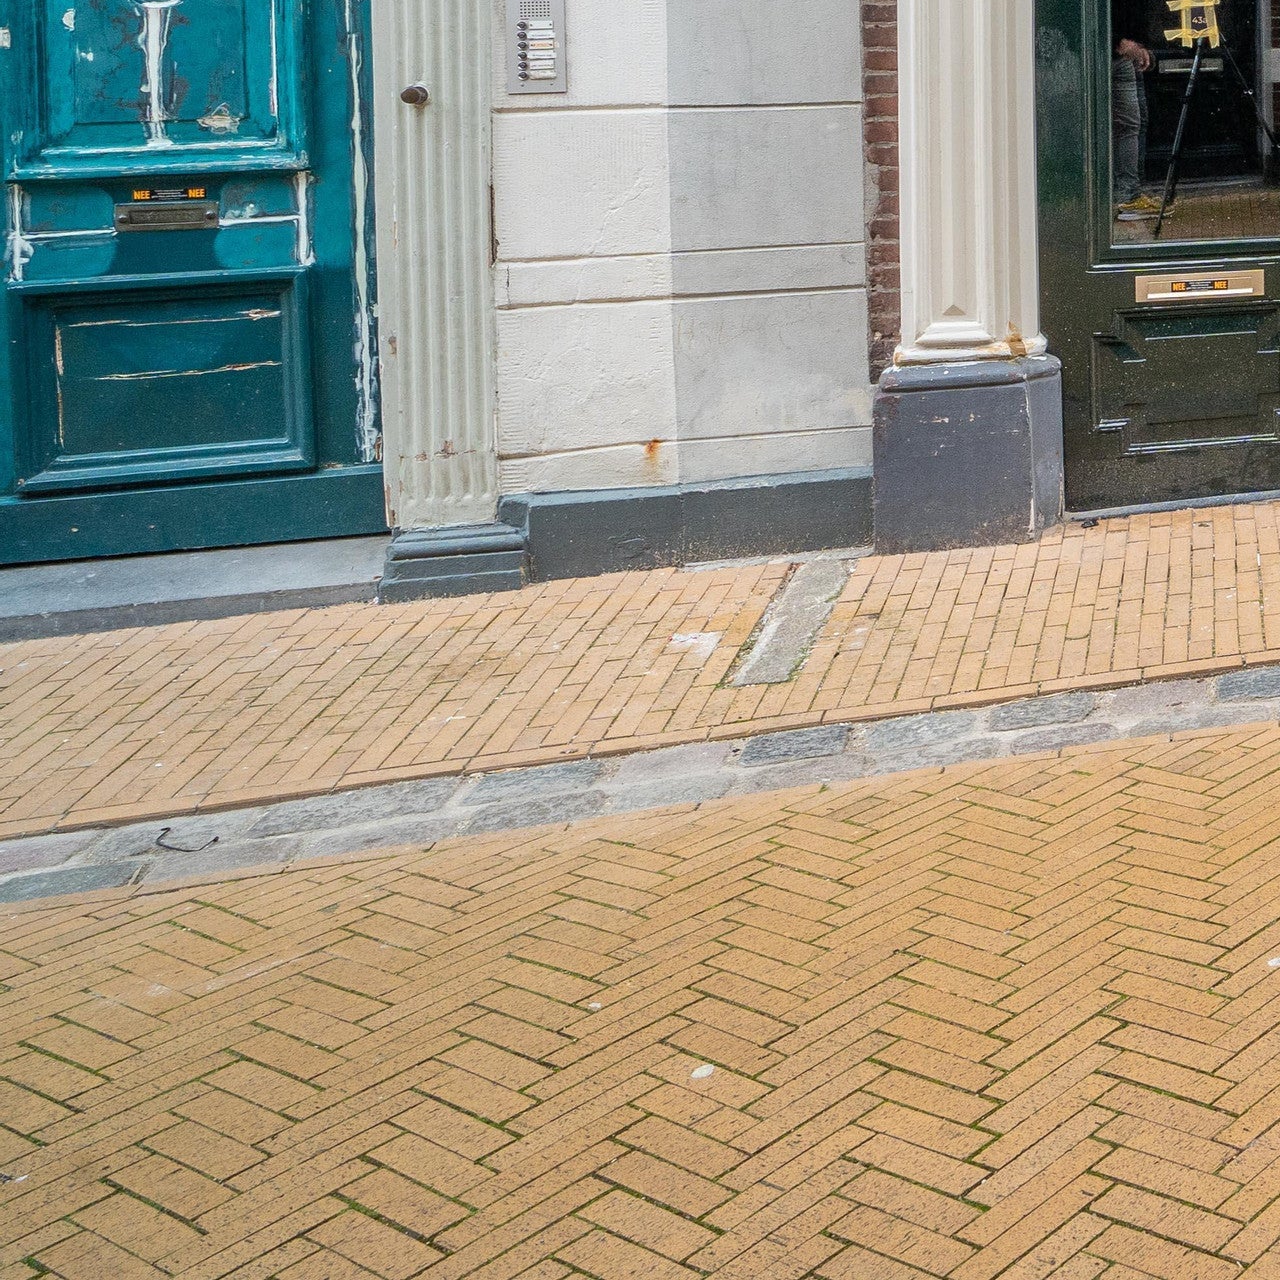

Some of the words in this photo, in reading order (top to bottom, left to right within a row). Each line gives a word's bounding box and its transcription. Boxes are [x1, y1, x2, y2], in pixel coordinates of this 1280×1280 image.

[133, 190, 151, 200] NEE
[188, 188, 205, 198] NEE
[1172, 282, 1186, 291] NEE
[1214, 280, 1227, 290] NEE
